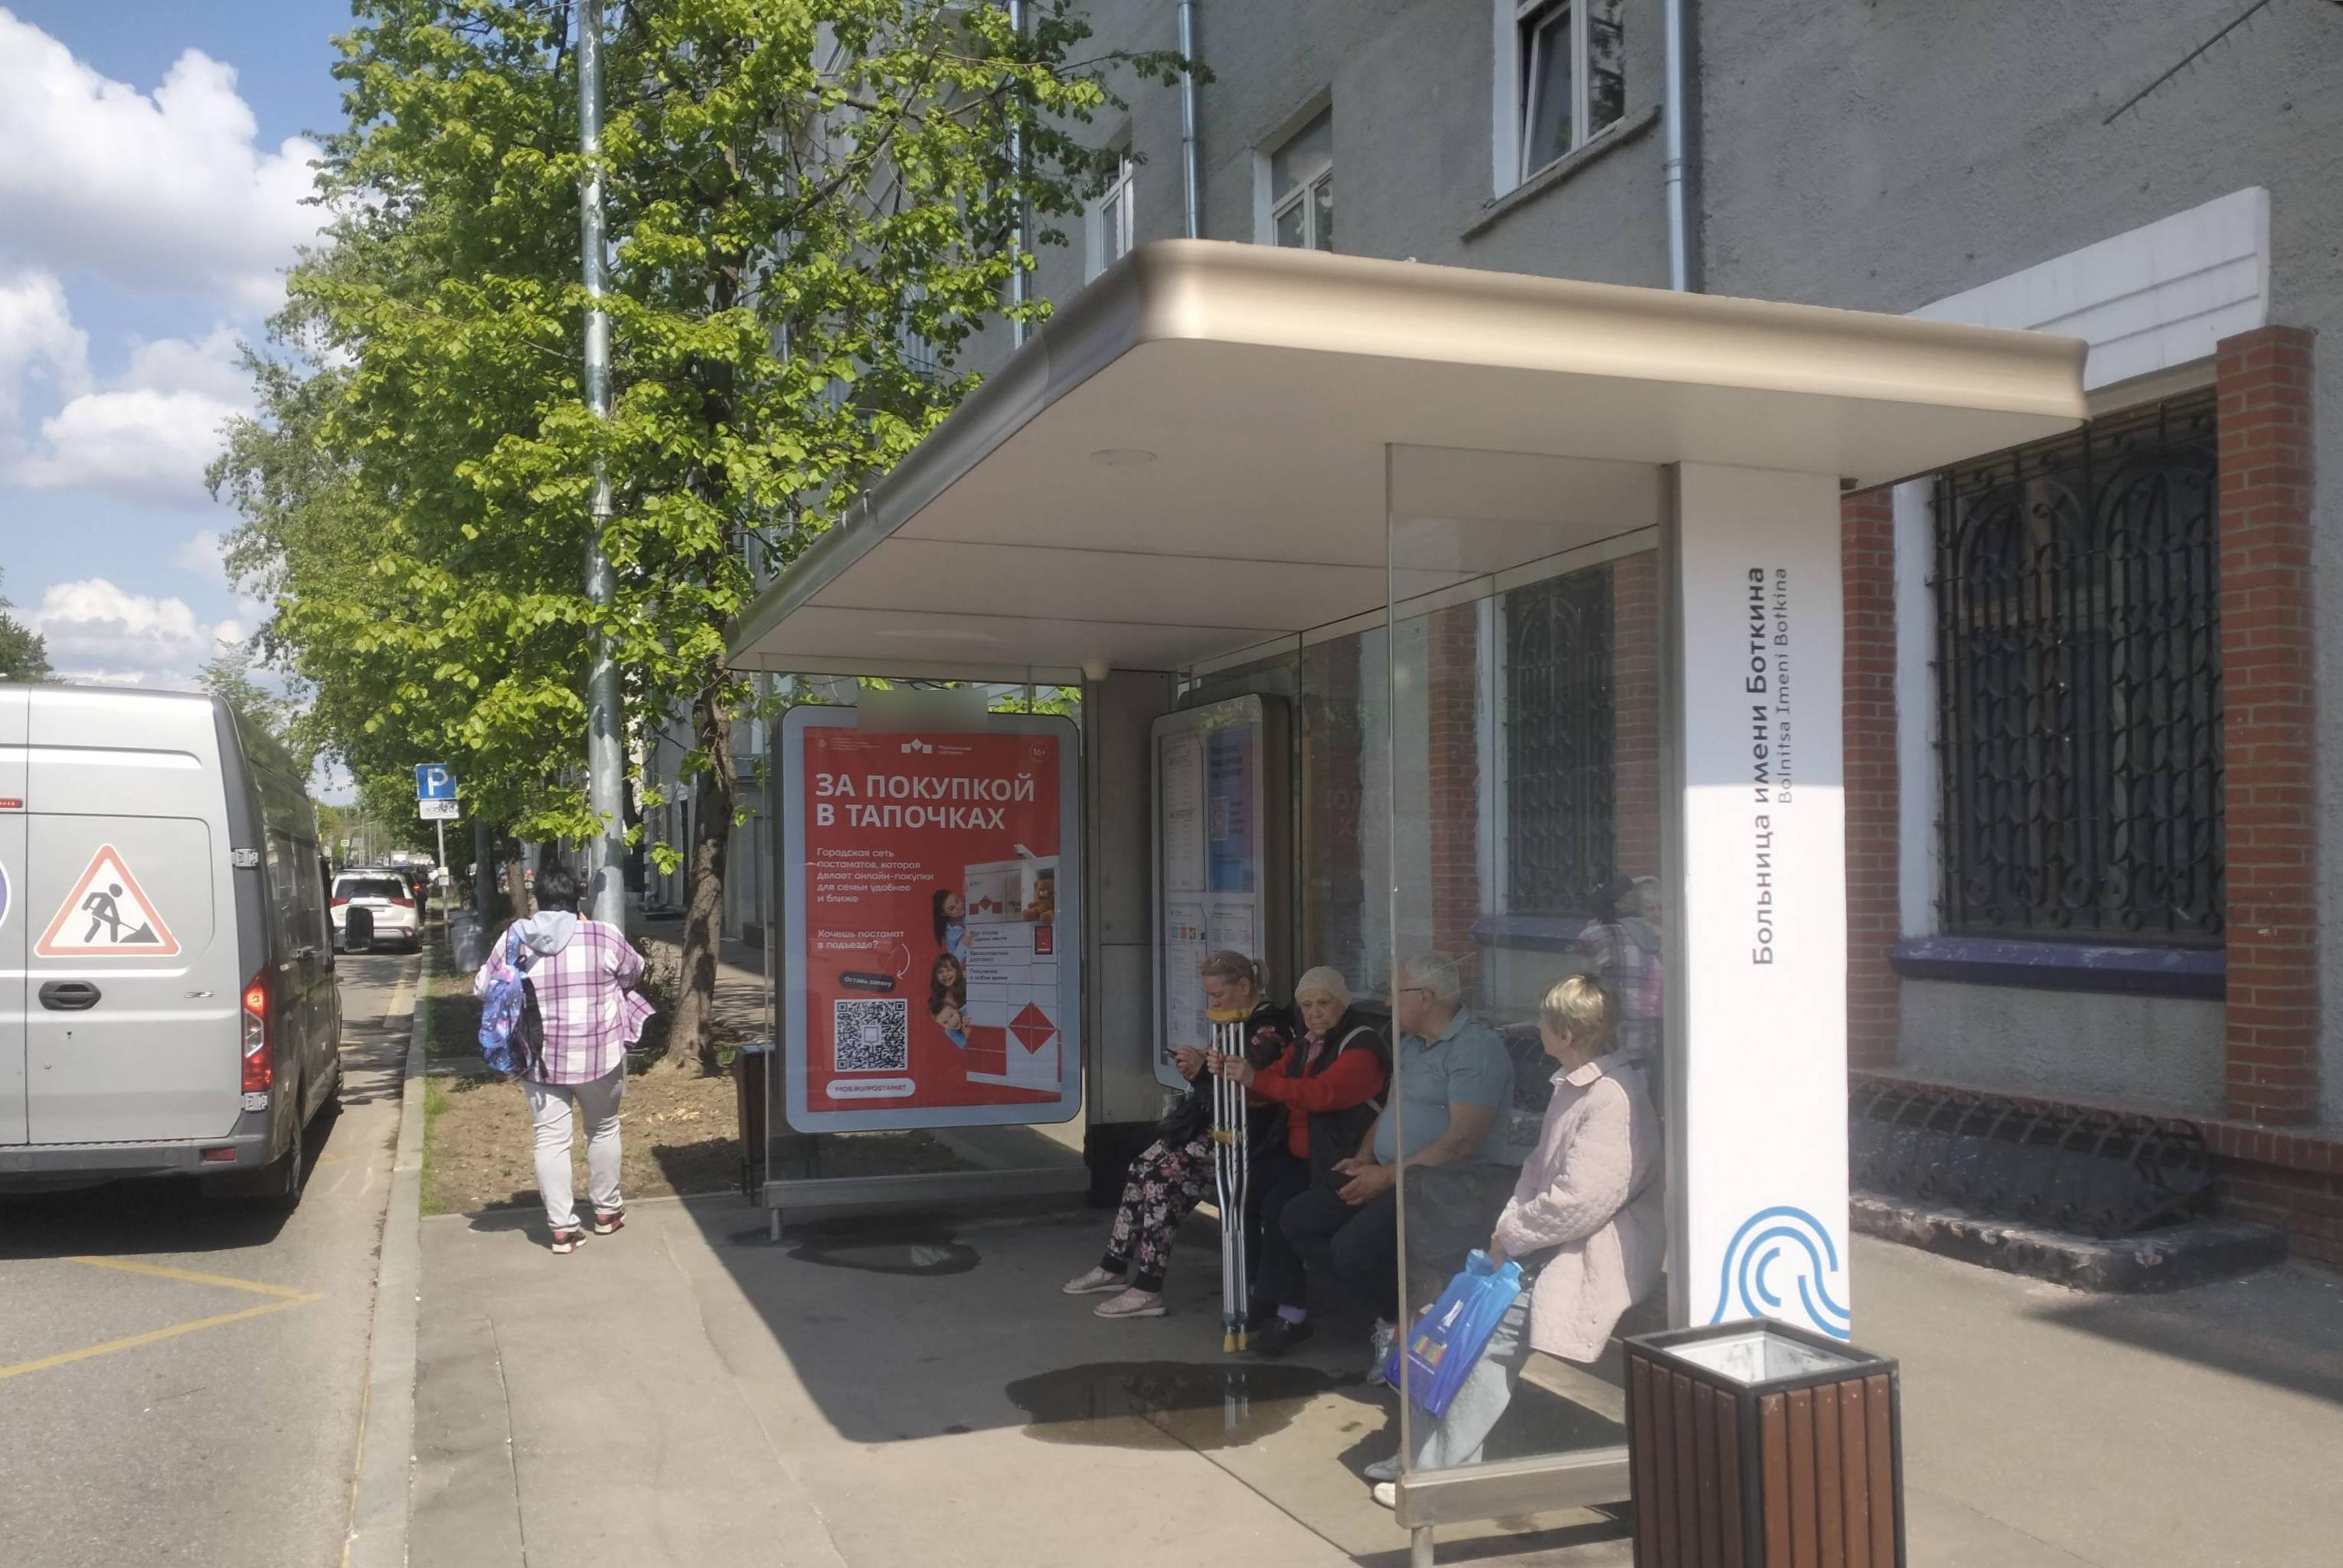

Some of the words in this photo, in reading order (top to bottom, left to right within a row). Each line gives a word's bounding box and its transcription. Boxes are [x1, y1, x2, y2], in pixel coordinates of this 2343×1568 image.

[1773, 568, 1789, 646] Botkina
[1747, 567, 1767, 694] Боткина
[1774, 653, 1790, 714] Imeni
[1752, 705, 1770, 803] имени
[1776, 721, 1792, 803] Bolnitsa
[427, 768, 448, 795] P
[815, 773, 856, 797] ЗА
[867, 773, 1034, 802] ПОКУПКОЙ
[817, 804, 835, 827] В
[845, 804, 1005, 829] ТАПОЧКАХ
[817, 848, 870, 858] Городская
[817, 861, 879, 870] постаматов,
[881, 862, 921, 871] которая
[817, 872, 852, 880] делает
[855, 871, 934, 882] онлайн-покупки
[817, 884, 835, 892] для
[870, 883, 911, 893] удобнее
[1753, 814, 1774, 965] Больница
[826, 893, 858, 903] ближе
[818, 929, 856, 938] Хочешь
